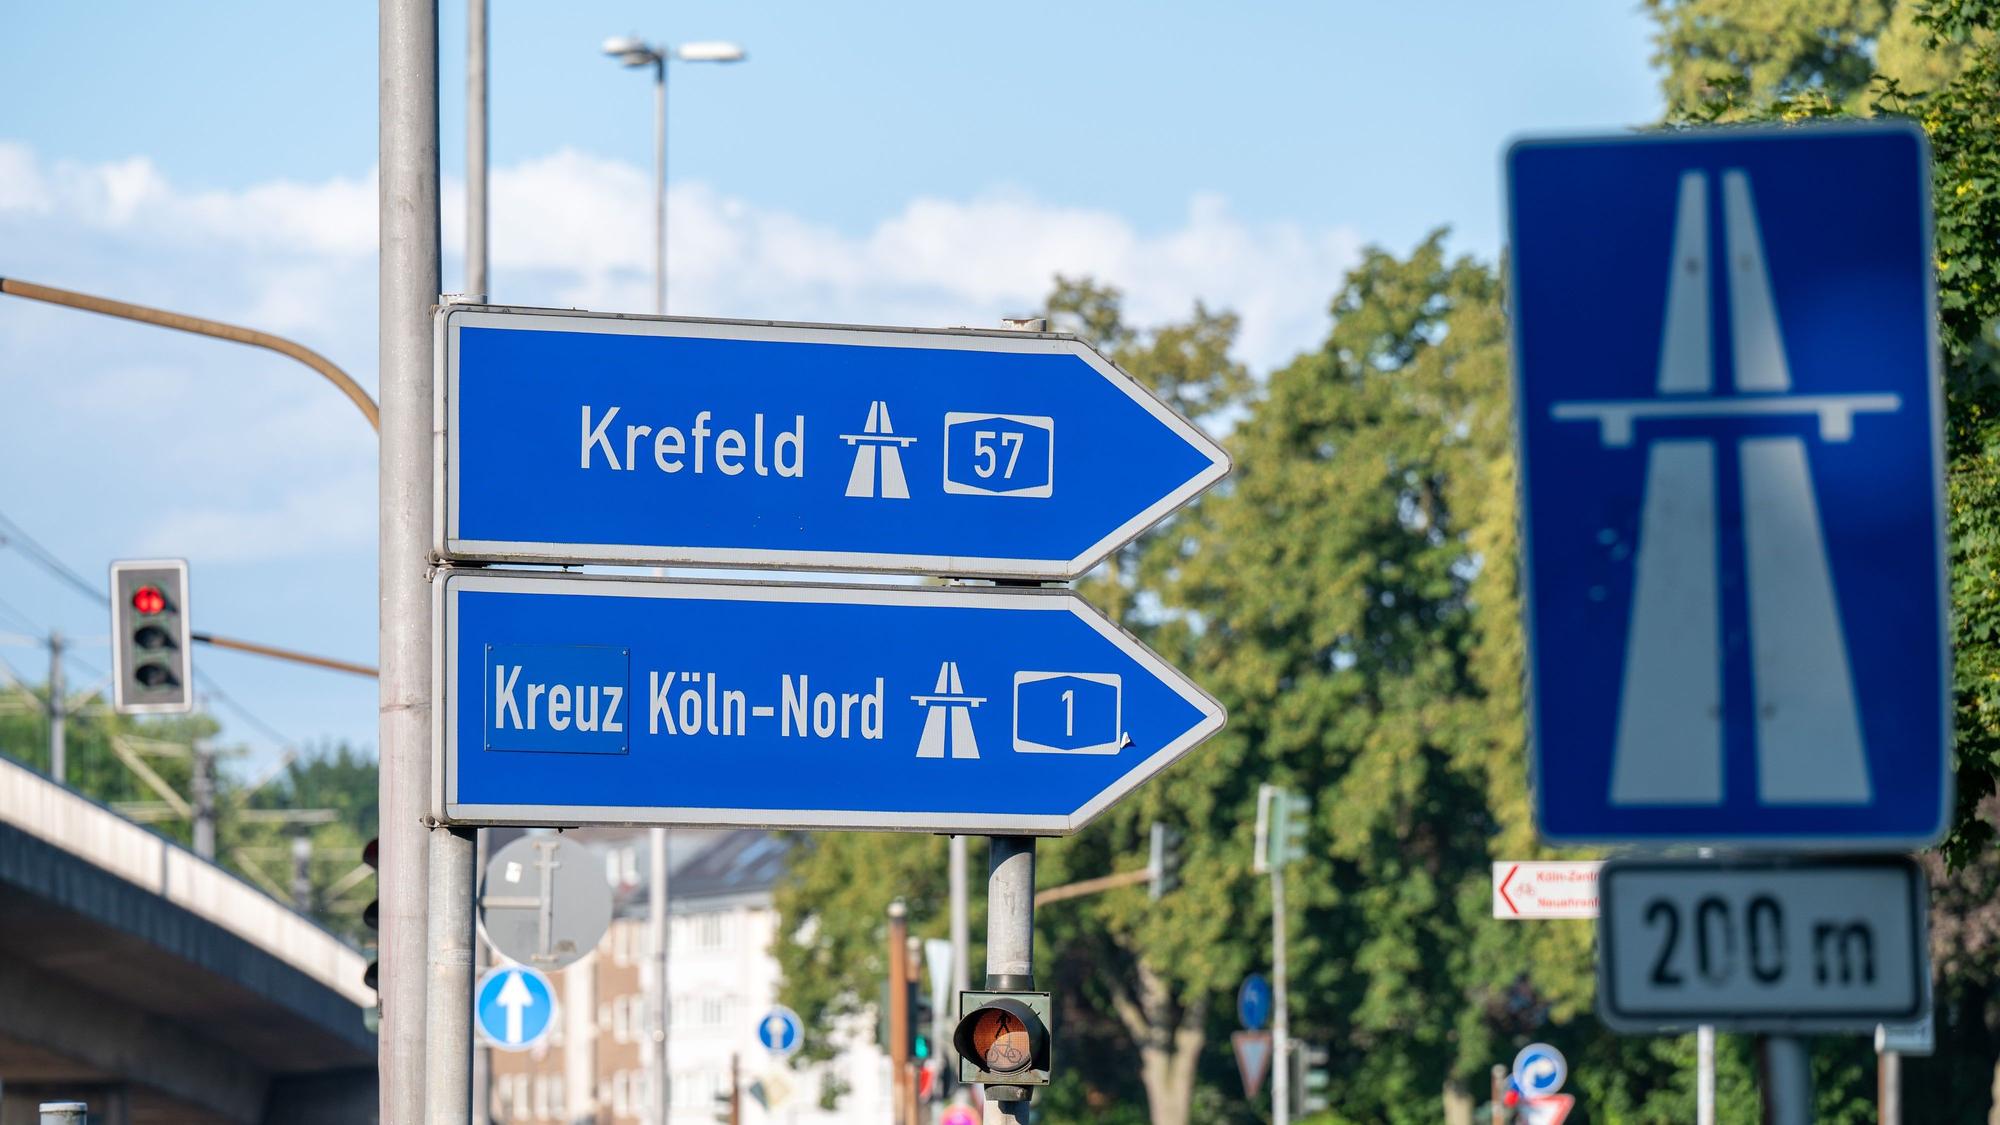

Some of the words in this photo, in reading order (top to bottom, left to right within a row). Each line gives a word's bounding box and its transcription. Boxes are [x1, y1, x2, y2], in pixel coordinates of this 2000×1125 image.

[581, 405, 804, 478] Krefeld
[974, 431, 1024, 479] 57
[495, 665, 623, 732] Kreuz
[649, 671, 884, 740] Köln-Nord
[1061, 689, 1074, 737] 1
[1645, 895, 1787, 986] 200
[1812, 918, 1876, 986] m
